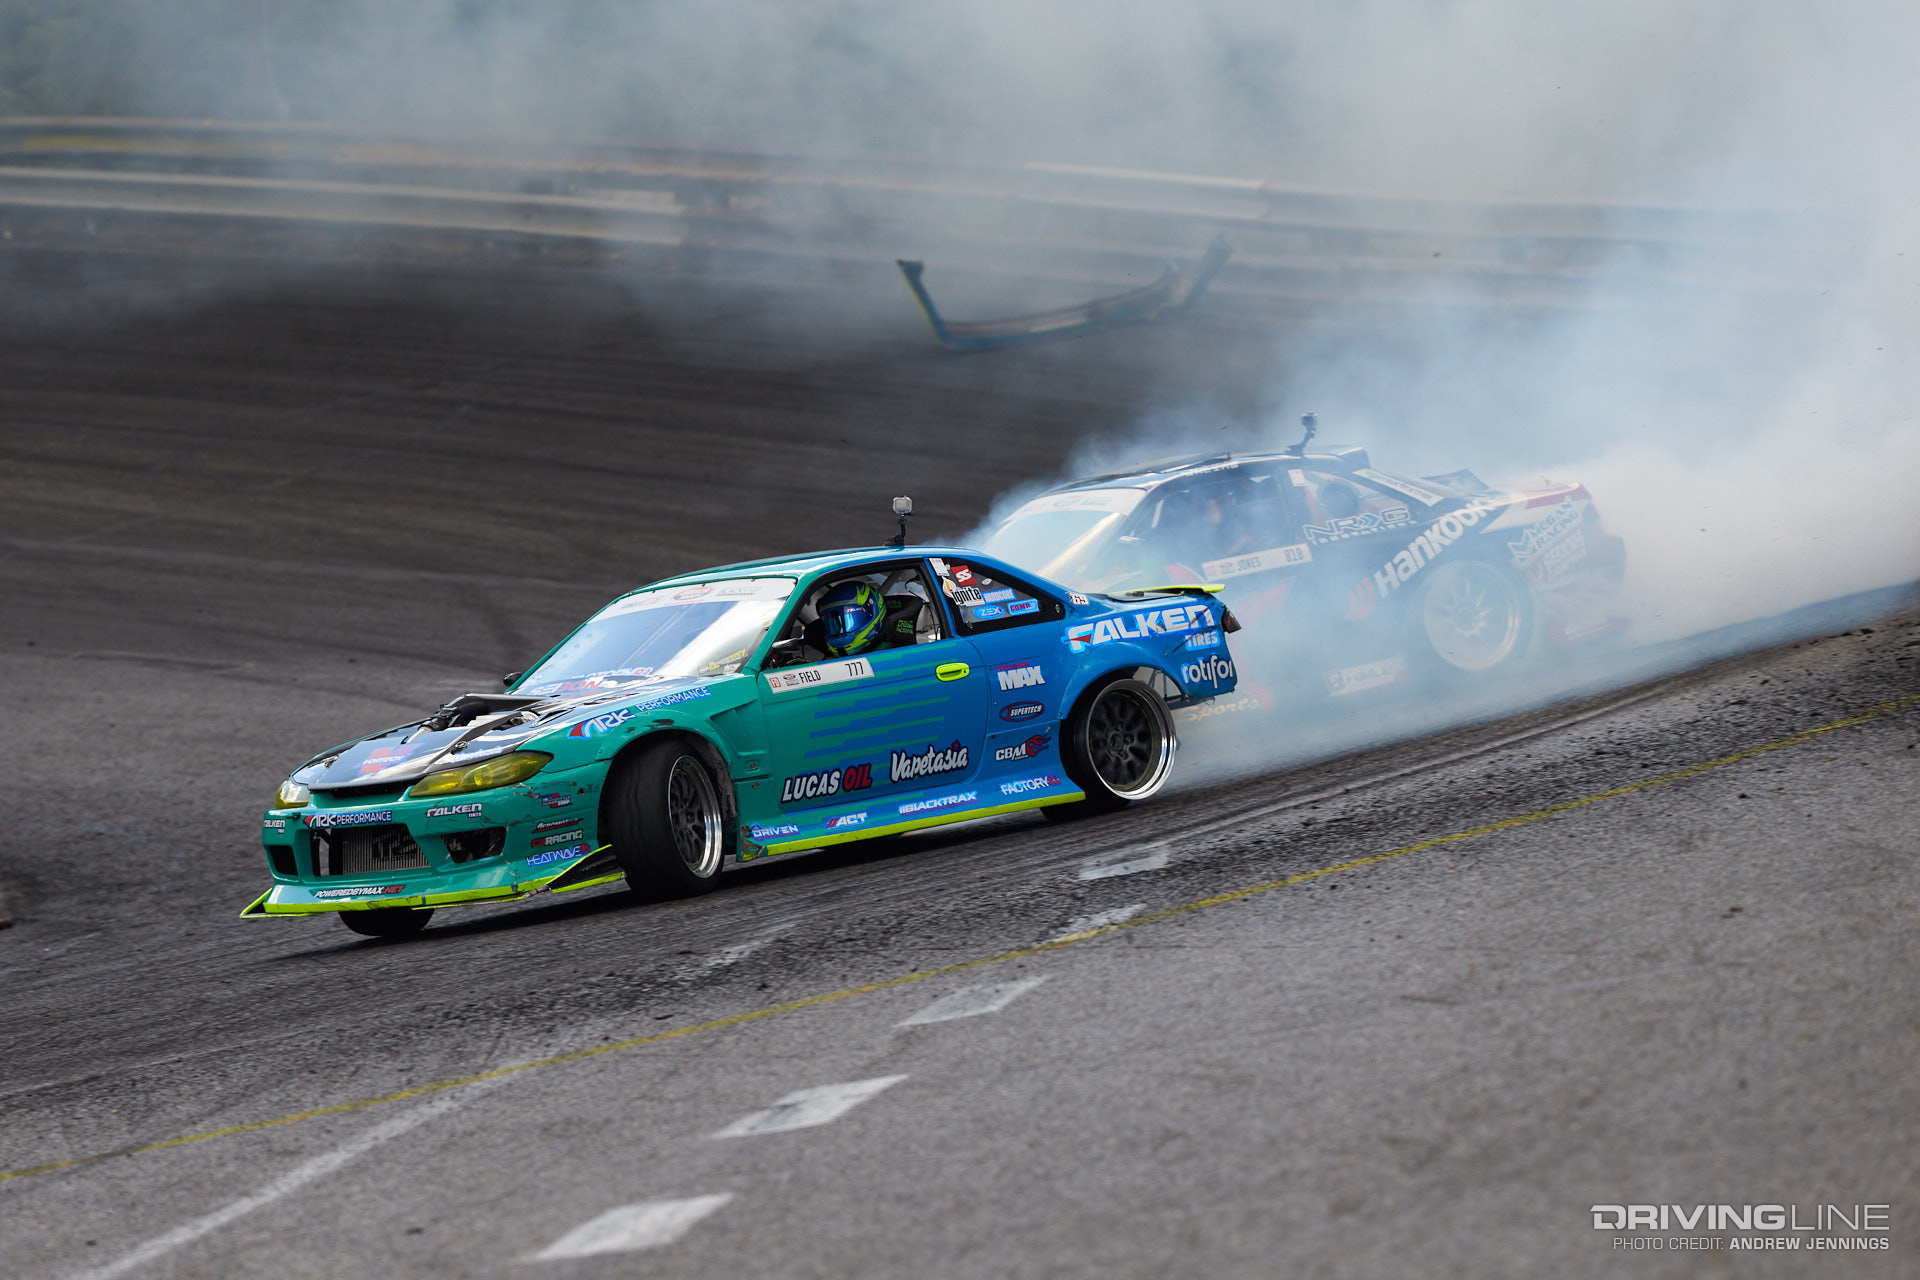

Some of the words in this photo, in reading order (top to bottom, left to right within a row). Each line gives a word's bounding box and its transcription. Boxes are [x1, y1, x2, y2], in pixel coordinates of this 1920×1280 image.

[1237, 556, 1262, 571] JONES
[951, 587, 982, 605] ignite
[1065, 604, 1215, 651] FALKEN
[1185, 631, 1219, 648] TIRES
[799, 670, 822, 684] FIELD
[845, 661, 864, 677] 777
[997, 665, 1046, 691] MAX
[636, 686, 711, 713] PERFORMANCE
[1010, 704, 1042, 717] SUPERTECH
[890, 739, 968, 783] Vapetasia
[995, 743, 1028, 761] CBM
[782, 770, 840, 802] LUCAS
[842, 764, 872, 792] OIL
[336, 811, 392, 825] PERFORMANCE
[427, 803, 482, 818] FALKEN
[751, 823, 799, 842] DRIVEN
